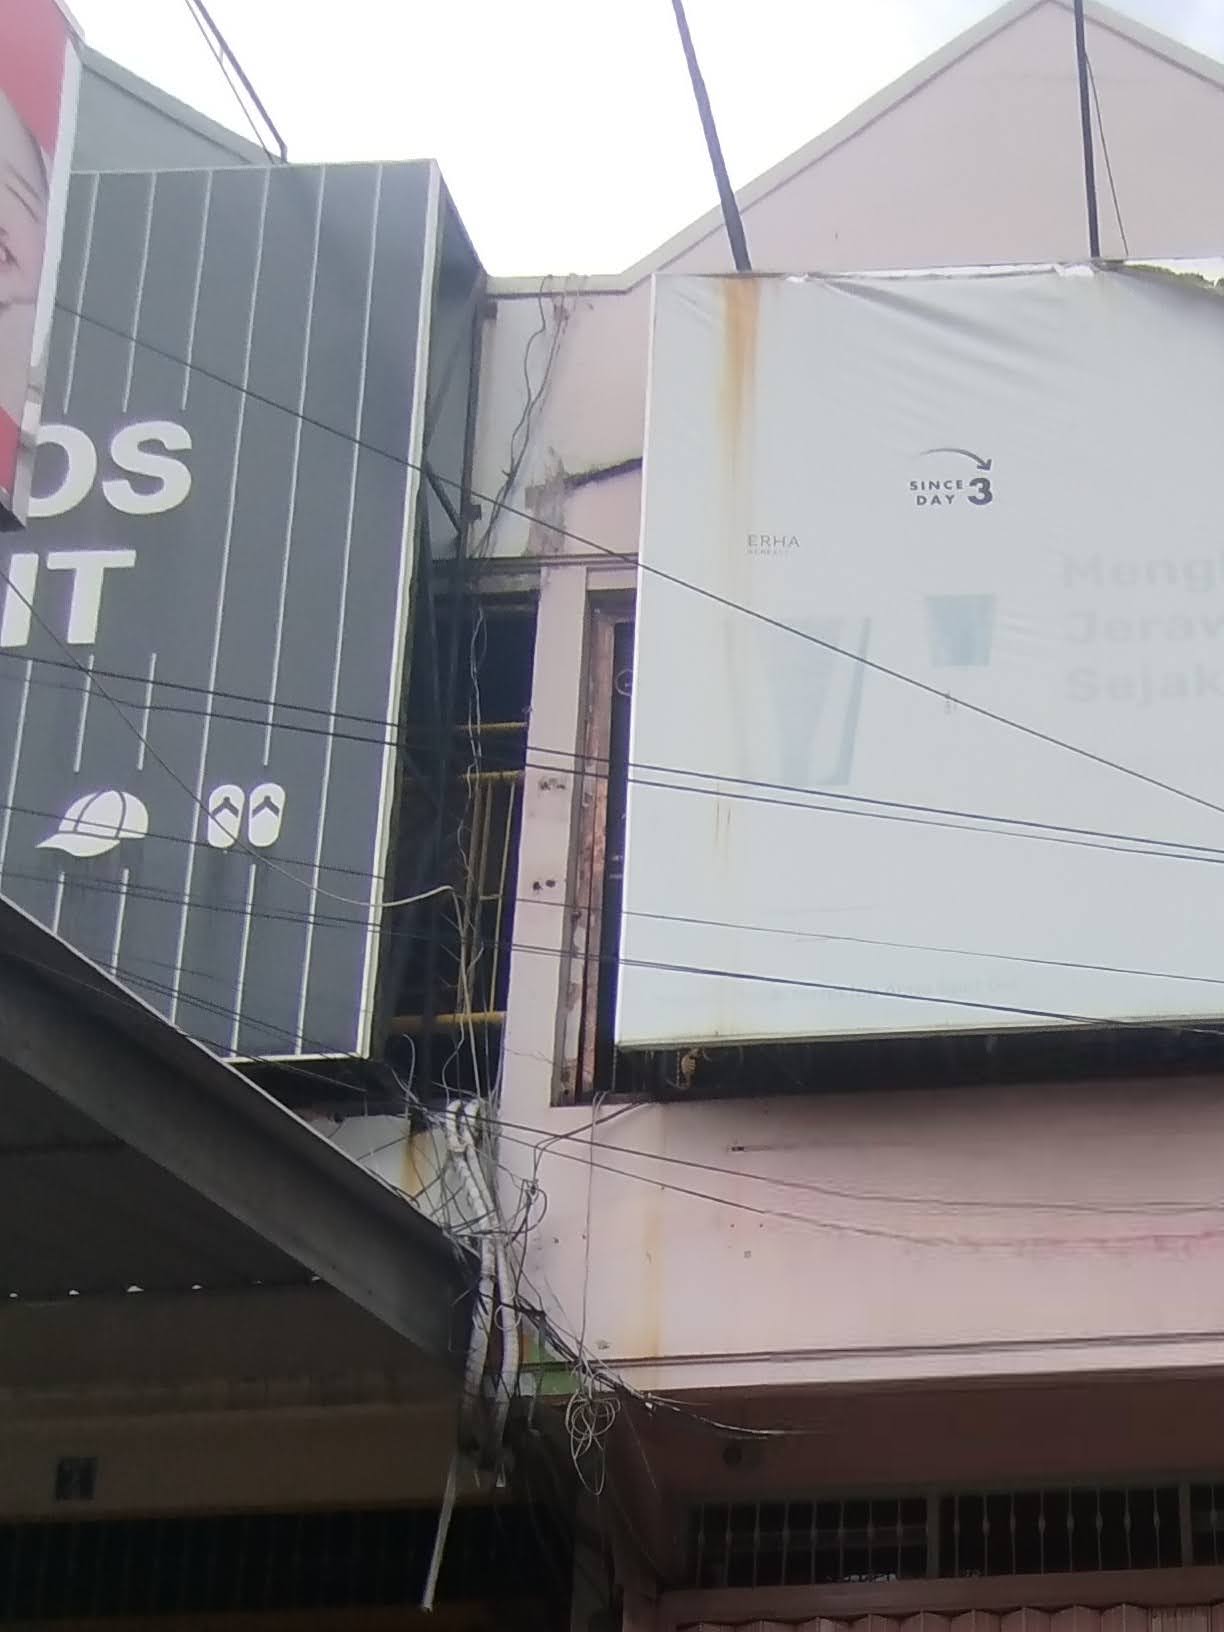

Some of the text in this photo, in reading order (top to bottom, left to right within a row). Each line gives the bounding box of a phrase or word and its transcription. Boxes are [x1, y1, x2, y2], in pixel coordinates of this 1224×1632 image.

[908, 479, 965, 492] SINCE
[915, 477, 994, 506] DAY 3
[747, 534, 801, 548] ERHA
